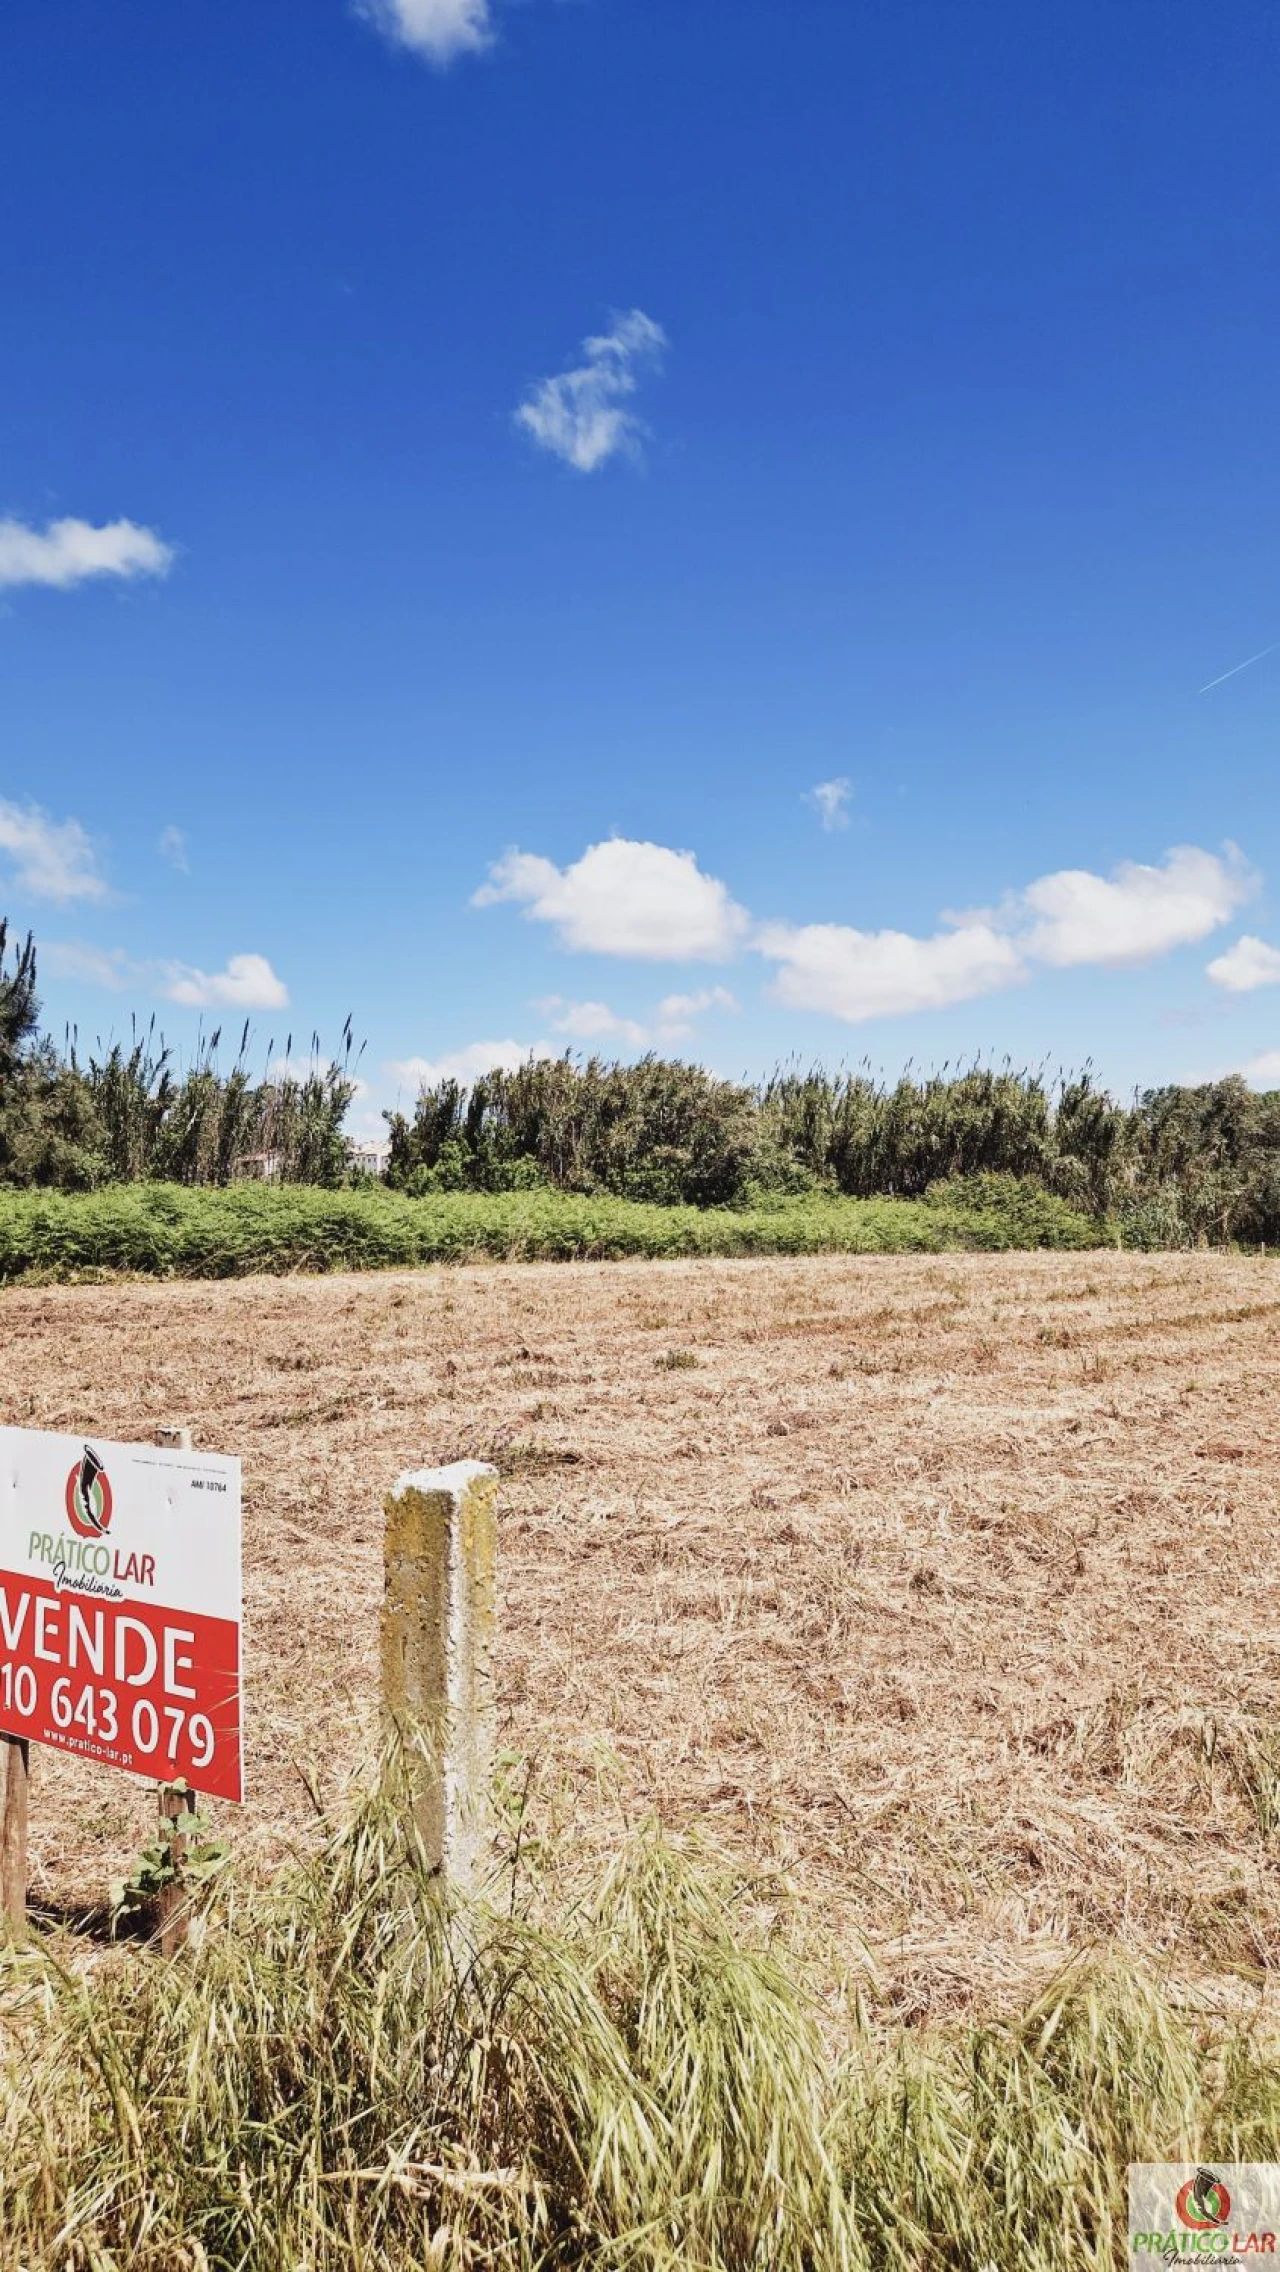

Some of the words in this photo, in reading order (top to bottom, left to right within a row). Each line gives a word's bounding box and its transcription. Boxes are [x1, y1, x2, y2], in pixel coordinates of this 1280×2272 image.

[29, 1531, 110, 1575] PRÁTICO
[114, 1549, 155, 1586] LAR
[43, 1728, 133, 1766] www.pratico-lar.pt
[51, 1677, 118, 1741] 643
[132, 1699, 215, 1766] 079
